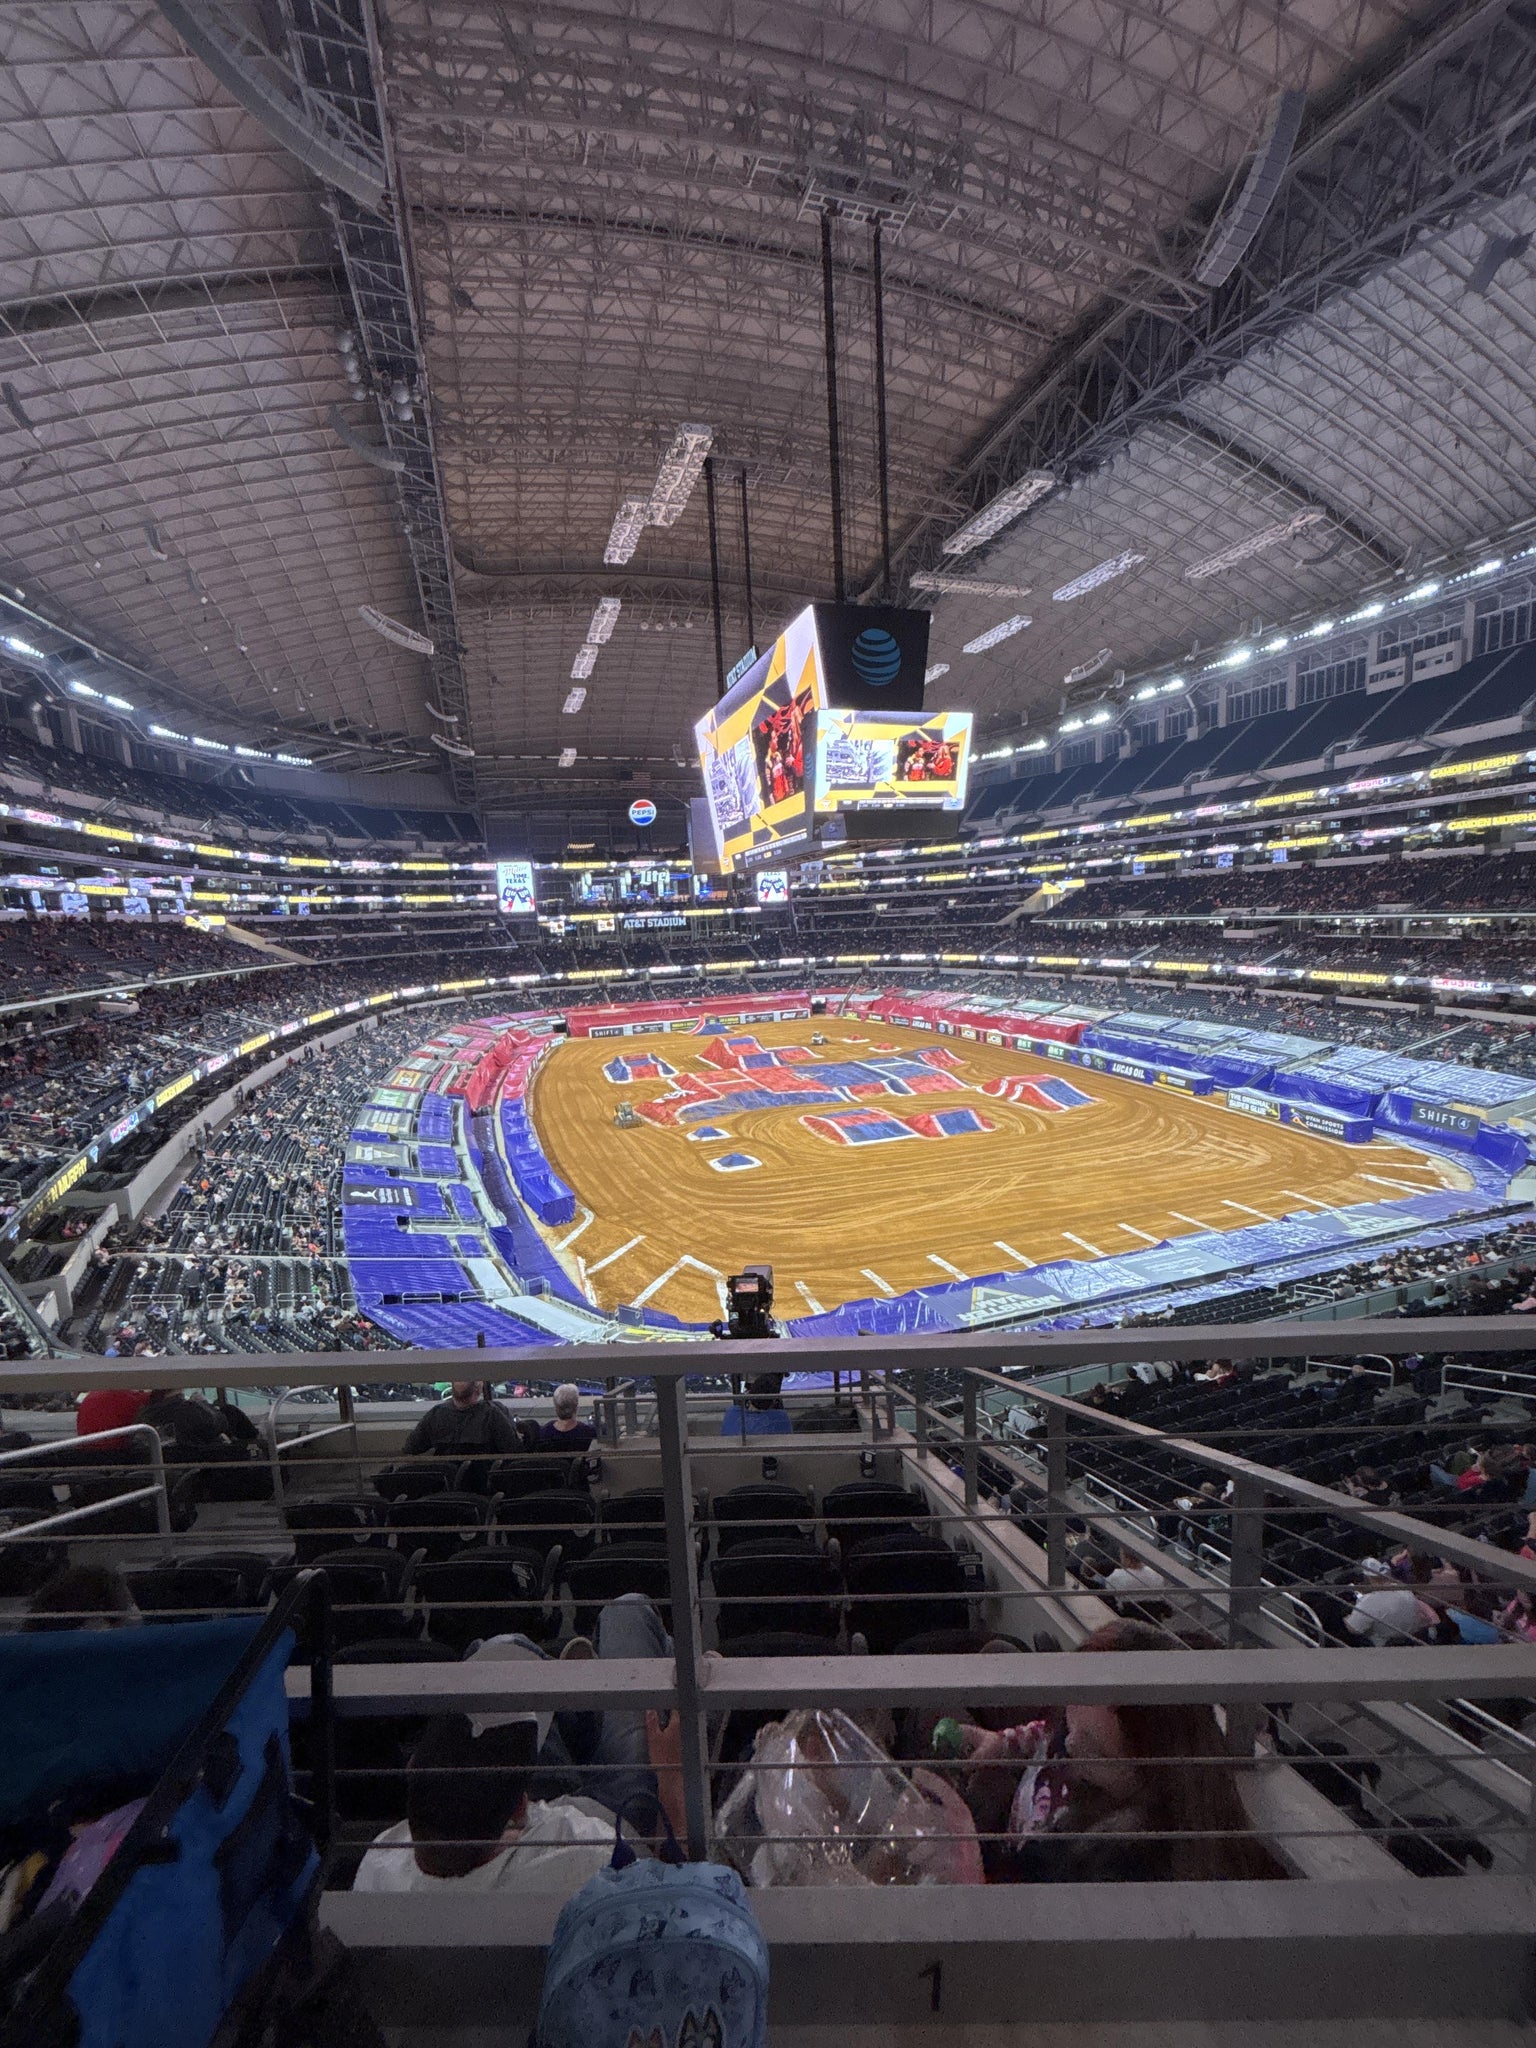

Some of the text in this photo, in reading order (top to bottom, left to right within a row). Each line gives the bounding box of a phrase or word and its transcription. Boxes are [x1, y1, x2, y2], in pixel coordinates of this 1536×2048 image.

[1429, 754, 1518, 779] CAMDEN MURPHY
[1447, 817, 1492, 831] CAMDEN
[640, 870, 666, 885] Lite
[623, 917, 686, 928] AT&T STADIUM
[568, 971, 596, 979] CAMDEN
[1310, 971, 1387, 984] CAMDEN MURPHY
[1435, 978, 1491, 991] CRUSHER
[1112, 1062, 1145, 1080] LUCAS OIL
[1229, 1100, 1267, 1116] SUPER GLUE
[1230, 1093, 1269, 1109] THE ORIGINAL
[1305, 1115, 1344, 1130] UTAH SPORTS
[1305, 1120, 1345, 1136] COMMISSION
[57, 1156, 87, 1196] MURPHY
[956, 1294, 1062, 1322] MONSTER
[974, 1294, 1025, 1309] JAM
[917, 1960, 943, 2012] 1
